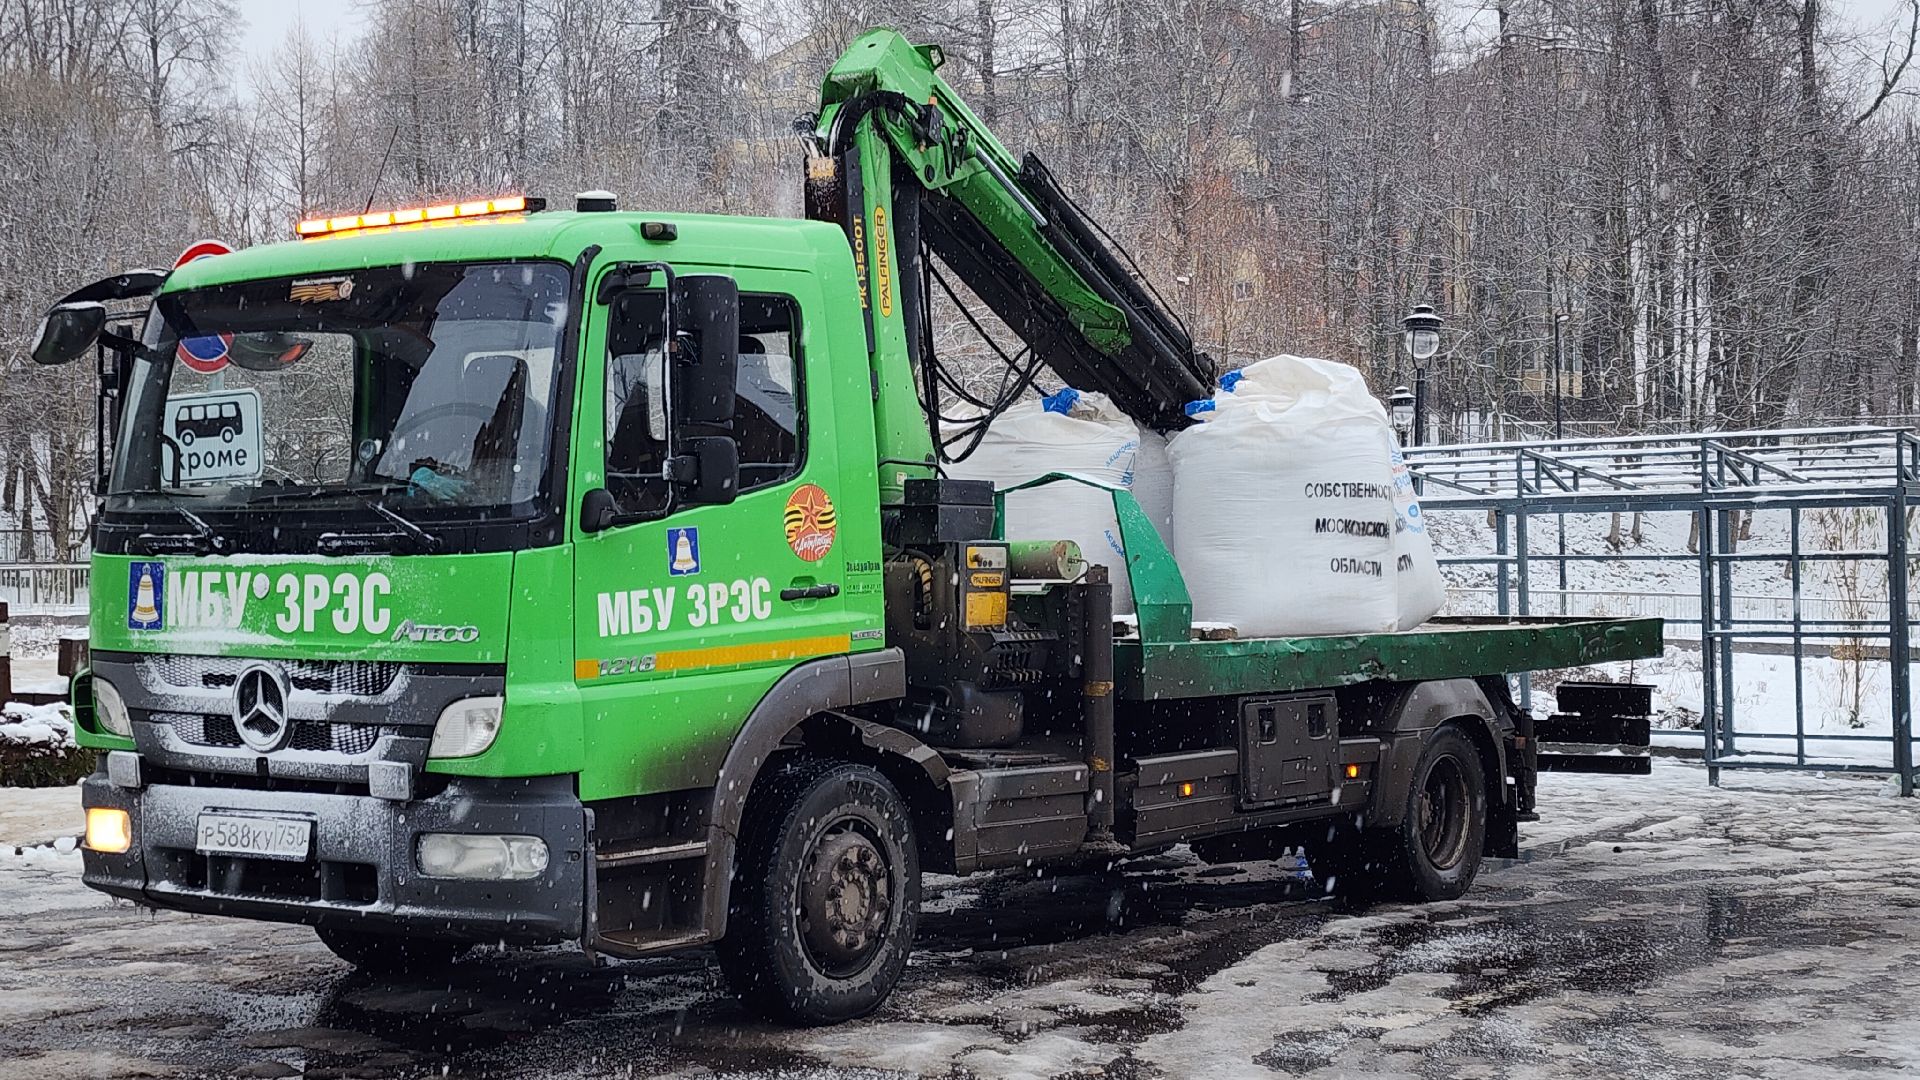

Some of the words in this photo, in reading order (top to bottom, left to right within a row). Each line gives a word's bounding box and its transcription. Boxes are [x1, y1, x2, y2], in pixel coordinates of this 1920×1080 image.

[876, 214, 890, 309] PALFINGER
[1330, 557, 1382, 577] ОБЛАСТИ
[167, 571, 251, 627] МБУ
[275, 572, 391, 634] ЗРЭС
[597, 586, 676, 637] МБУ
[686, 577, 772, 628] ЗРЭС
[598, 653, 656, 676] 1218
